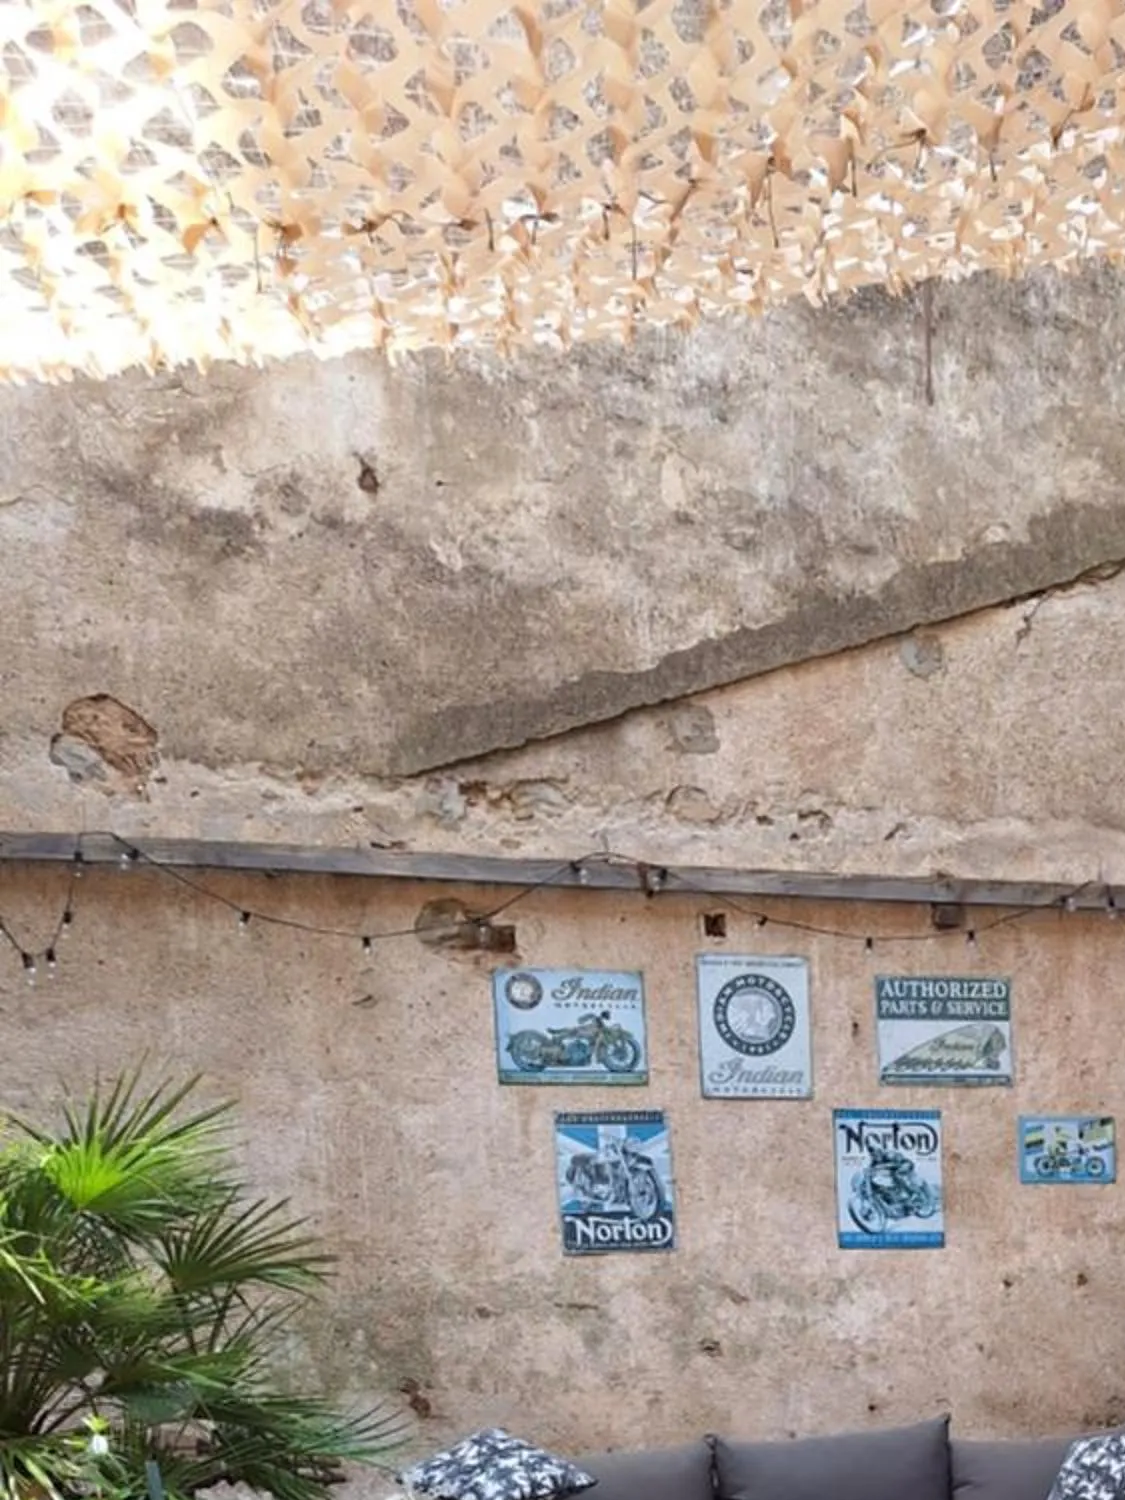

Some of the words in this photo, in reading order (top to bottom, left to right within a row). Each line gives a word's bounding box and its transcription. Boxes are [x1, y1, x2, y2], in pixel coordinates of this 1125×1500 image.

[551, 976, 638, 1001] Indian
[881, 981, 1007, 998] AUTHORIZED
[881, 1000, 928, 1014] PARTS
[946, 1001, 1009, 1015] SERVICE
[707, 1057, 804, 1084] Indian
[838, 1120, 938, 1156] Norton
[564, 1216, 673, 1246] Norton
